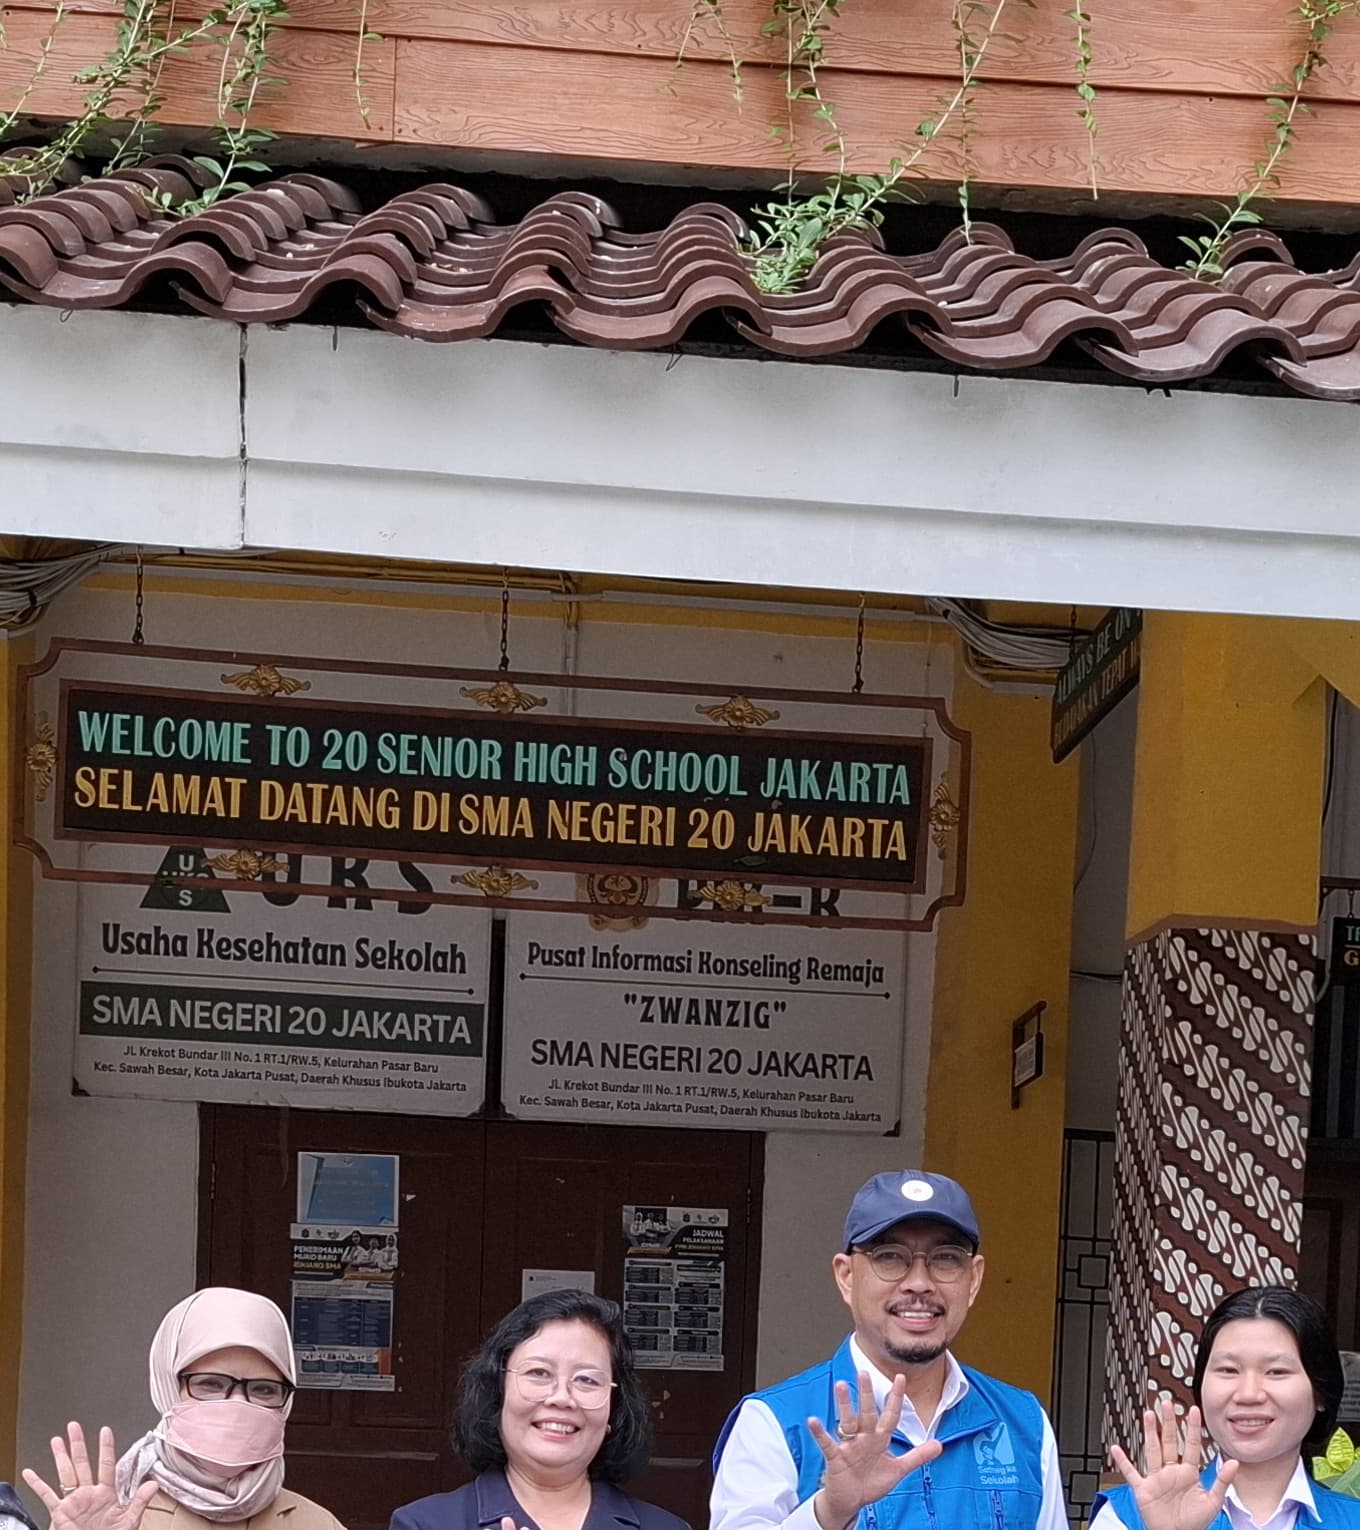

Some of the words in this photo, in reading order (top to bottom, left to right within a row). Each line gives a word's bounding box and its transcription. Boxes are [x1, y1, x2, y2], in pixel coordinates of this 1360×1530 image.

[1096, 622, 1112, 663] BE
[78, 710, 252, 764] WELCOME
[266, 724, 310, 768] TO
[321, 729, 368, 771] 20
[377, 732, 502, 780] SENIOR
[513, 741, 597, 786] HIGH
[608, 747, 748, 796] SCHOOL
[760, 757, 910, 806] JAKARTA
[74, 766, 248, 818] SELAMAT
[259, 779, 400, 830] DATANG
[412, 790, 450, 833] DI
[458, 793, 535, 840] SMA
[547, 799, 676, 847] NEGERI
[687, 808, 735, 850] 20
[747, 811, 907, 861] JAKARTA
[179, 854, 194, 871] U
[179, 889, 193, 906] S
[102, 922, 188, 957] Usaha
[197, 927, 347, 968] Kesehatan
[355, 936, 467, 975] Sekolah
[527, 941, 586, 969] Pusat
[591, 944, 693, 974] Informasi
[698, 951, 802, 985] Konseling
[806, 956, 885, 989] Remaja
[92, 994, 163, 1027] SMA
[169, 1000, 281, 1034] NEGERI
[288, 1006, 327, 1036] 20
[332, 1010, 472, 1045] JAKARTA
[623, 993, 787, 1029] "ZWANZIG"
[94, 1061, 116, 1073] Kec.
[119, 1063, 155, 1075] Sawah
[158, 1065, 191, 1078] Besar,
[194, 1067, 219, 1078] Kota
[222, 1068, 262, 1081] Jakarta
[265, 1071, 298, 1084] Pusat,
[301, 1073, 339, 1085] Daerah
[342, 1075, 381, 1087] Khusus
[383, 1077, 425, 1090] Ibukota
[426, 1080, 467, 1092] Jakarta
[140, 1046, 175, 1058] Krekot
[178, 1049, 218, 1061] Bundar
[221, 1051, 231, 1062] III
[234, 1052, 252, 1063] No.
[254, 1053, 262, 1063] 1
[324, 1057, 379, 1070] Kelurahan
[381, 1060, 411, 1072] Pasar
[414, 1062, 439, 1073] Baru
[530, 1038, 595, 1068] SMA
[600, 1042, 701, 1073] NEGERI
[707, 1047, 741, 1075] 20
[747, 1050, 874, 1081] JAKARTA
[519, 1095, 541, 1105] Kec.
[544, 1096, 578, 1108] Sawah
[581, 1098, 614, 1112] Besar,
[616, 1099, 641, 1111] Kota
[643, 1101, 683, 1113] Jakarta
[685, 1103, 718, 1116] Pusat,
[720, 1104, 758, 1116] Daerah
[760, 1106, 798, 1118] Khusus
[800, 1108, 840, 1120] Ibukota
[842, 1110, 881, 1122] Jakarta
[564, 1080, 599, 1092] Krekot
[601, 1082, 640, 1094] Bundar
[642, 1084, 653, 1094] III
[655, 1085, 674, 1096] No.
[675, 1086, 682, 1096] 1
[742, 1088, 795, 1101] Kelurahan
[798, 1091, 827, 1103] Pasar
[829, 1093, 854, 1104] Baru
[693, 1228, 724, 1238] JADWAL
